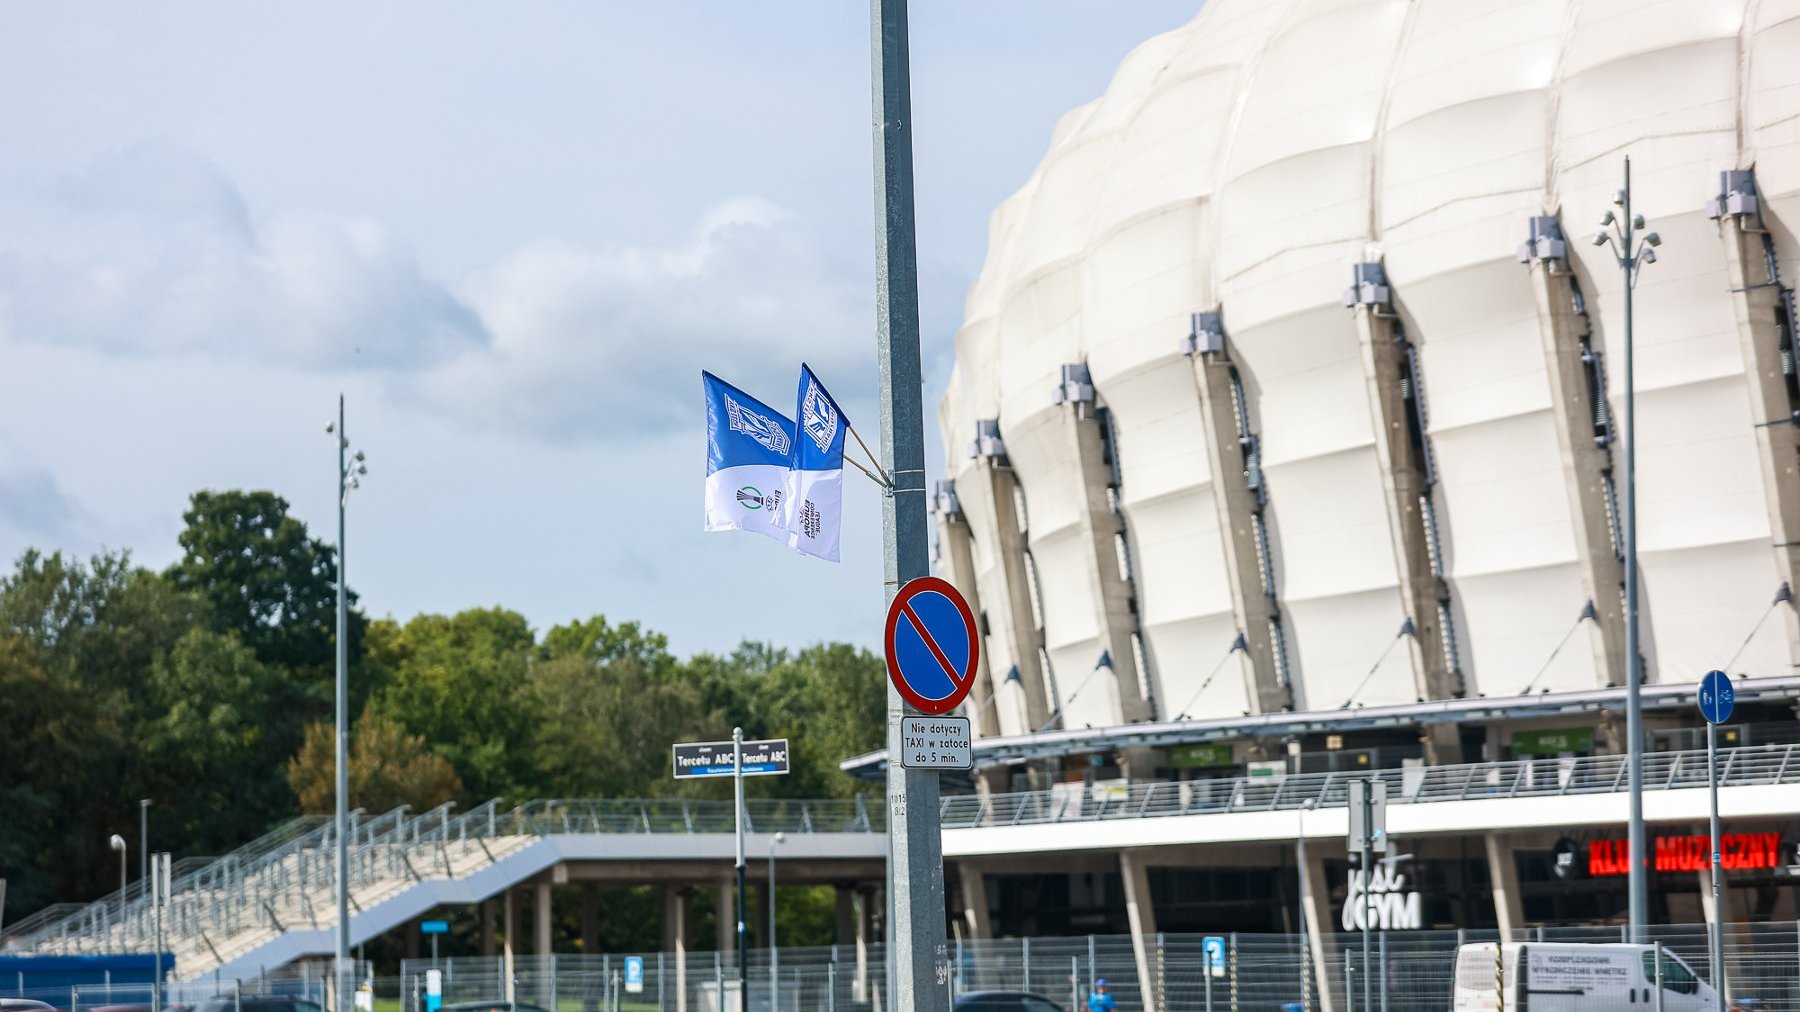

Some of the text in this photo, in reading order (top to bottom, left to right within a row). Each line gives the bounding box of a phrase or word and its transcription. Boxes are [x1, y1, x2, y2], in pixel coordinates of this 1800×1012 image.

[911, 723, 961, 736] Nie dotyczy
[905, 738, 924, 748] TAXI
[940, 740, 968, 748] zatoce
[714, 752, 734, 765] ABC
[770, 750, 786, 762] ABC
[915, 752, 959, 763] do 5 min.
[1590, 832, 1779, 875] KLU MUZCZNY
[1354, 892, 1421, 930] GYM
